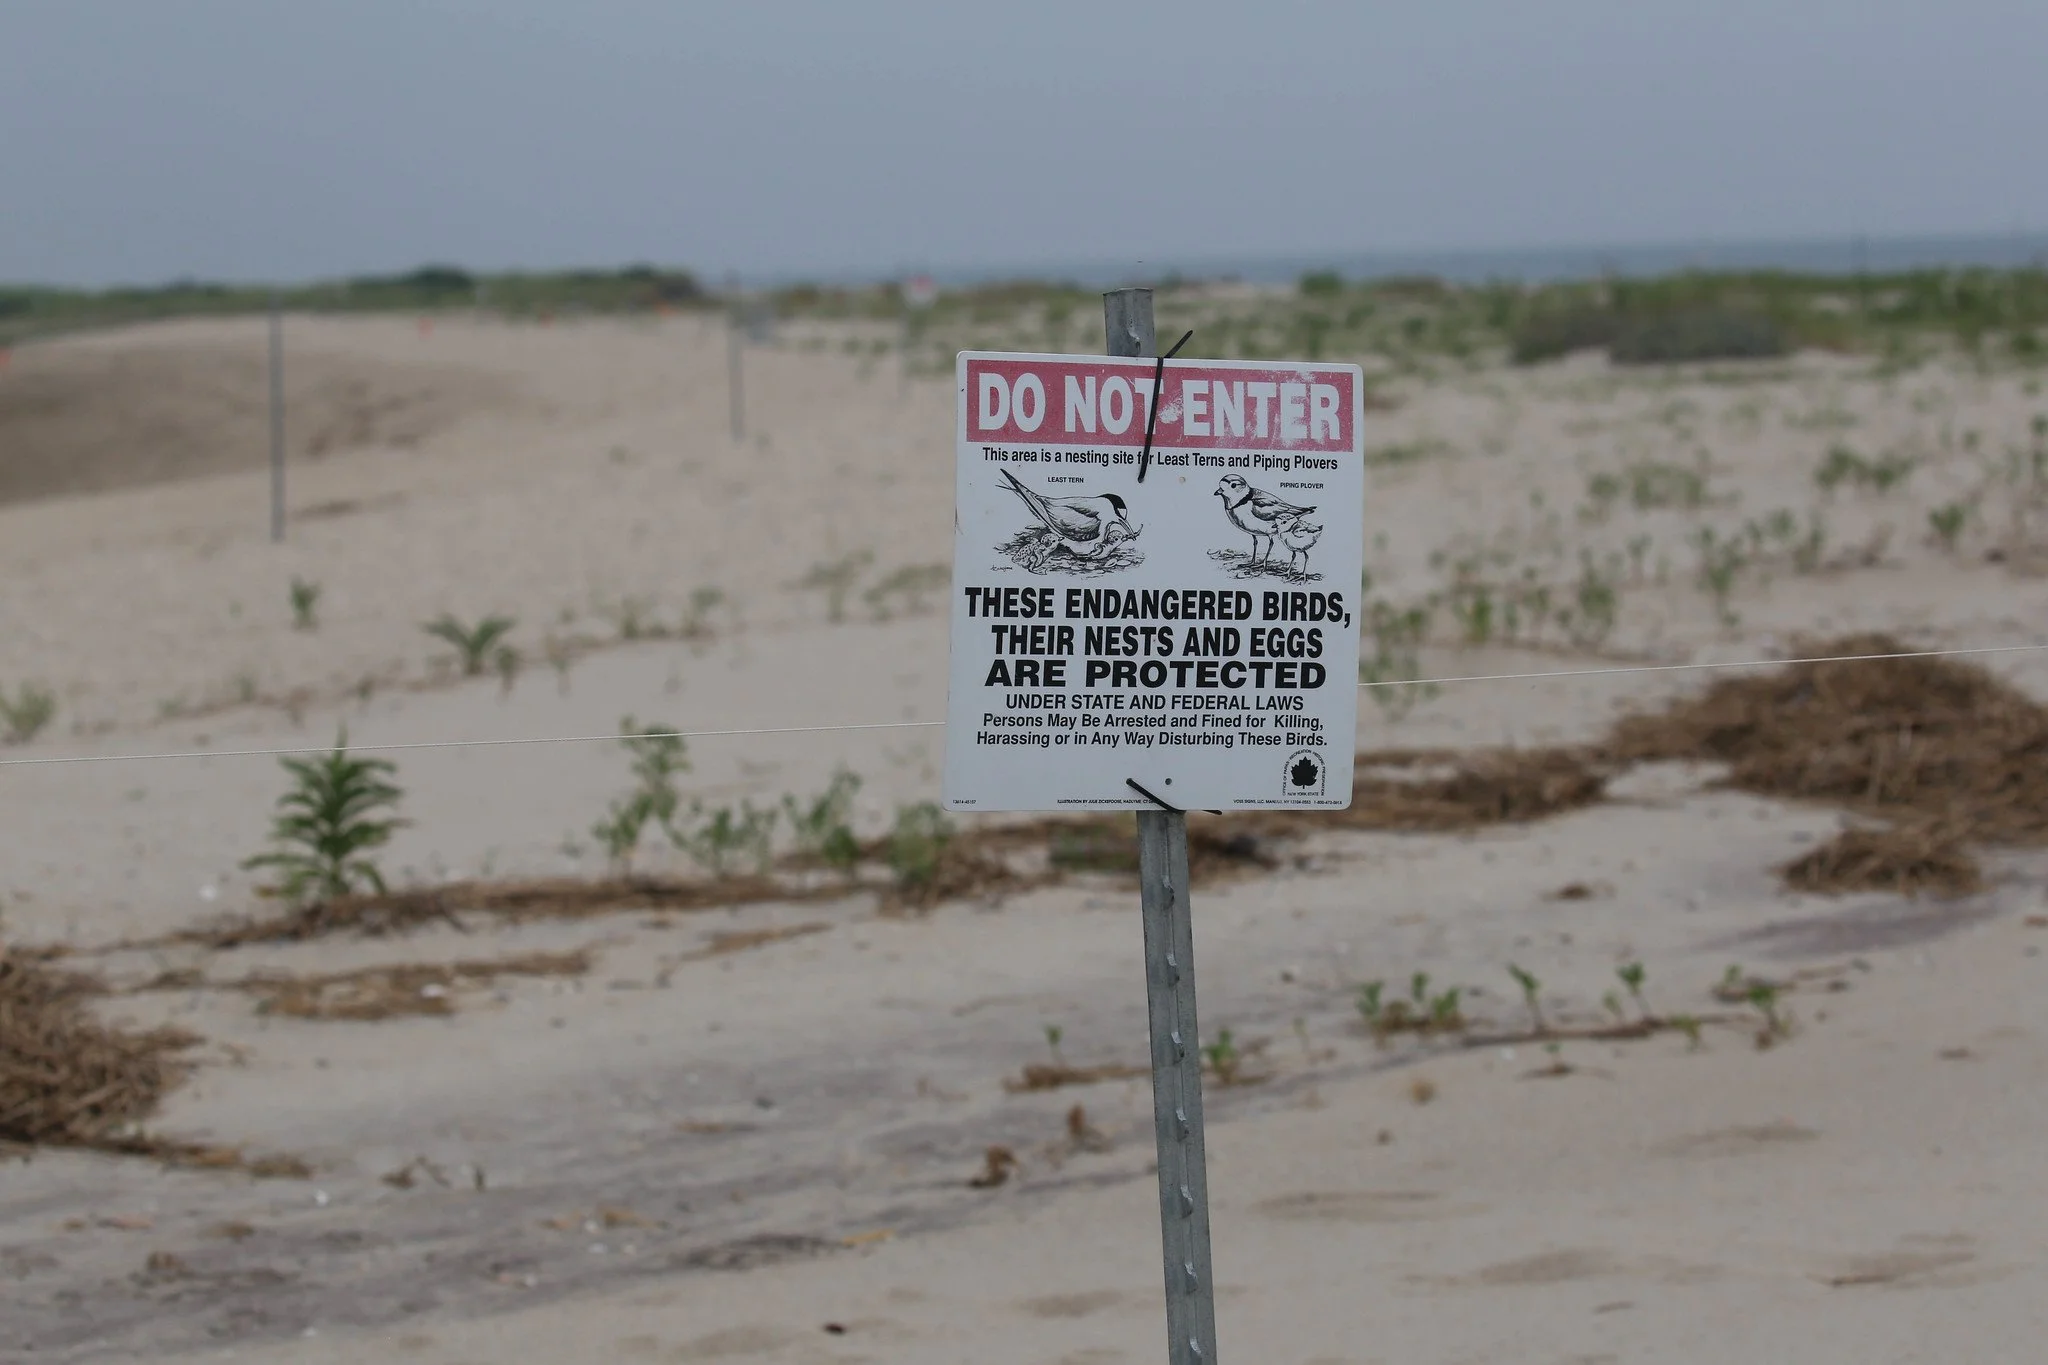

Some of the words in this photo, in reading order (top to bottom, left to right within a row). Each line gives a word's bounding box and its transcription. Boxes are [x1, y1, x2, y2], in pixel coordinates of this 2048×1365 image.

[979, 373, 1046, 432] DO
[1065, 376, 1164, 435] NOT
[1182, 380, 1341, 440] ENTER
[982, 446, 1008, 461] This
[1011, 450, 1037, 462] area
[1040, 448, 1051, 462] is
[1054, 451, 1061, 462] a
[1065, 449, 1109, 467] nesting
[1112, 450, 1134, 464] site
[1137, 451, 1154, 465] fr
[1157, 451, 1189, 466] Least
[1191, 452, 1224, 466] Terns
[1227, 453, 1249, 467] and
[1253, 453, 1290, 471] Piping
[1294, 454, 1337, 469] Plovers
[964, 586, 1054, 618] THESE
[1065, 588, 1252, 620] ENDANGERED
[1262, 591, 1350, 628] BIRDS,
[991, 624, 1074, 655] THEIR
[1084, 625, 1173, 656] NESTS
[1182, 626, 1240, 656] AND
[1249, 627, 1322, 658] EGGS
[984, 659, 1066, 687] ARE
[1085, 659, 1326, 688] PROTECTED
[1005, 693, 1066, 709] UNDER
[1070, 693, 1124, 709] STATE
[1128, 694, 1166, 709] AND
[1171, 694, 1250, 710] FEDERAL
[1255, 695, 1303, 710] LAWS
[983, 712, 1042, 727] Persons
[1047, 713, 1077, 730] May
[1081, 713, 1100, 727] Be
[1103, 713, 1166, 727] Arrested
[1170, 713, 1197, 727] and
[1201, 713, 1241, 727] Fined
[1245, 714, 1266, 727] for
[1274, 714, 1323, 731] Killing,
[976, 730, 1050, 748] Harassing
[1054, 734, 1070, 745] or
[1074, 731, 1087, 744] in
[1090, 731, 1120, 748] Any
[1124, 731, 1154, 748] Way
[1158, 731, 1233, 748] Disturbing
[1237, 731, 1281, 745] These
[1285, 731, 1327, 746] Birds.
